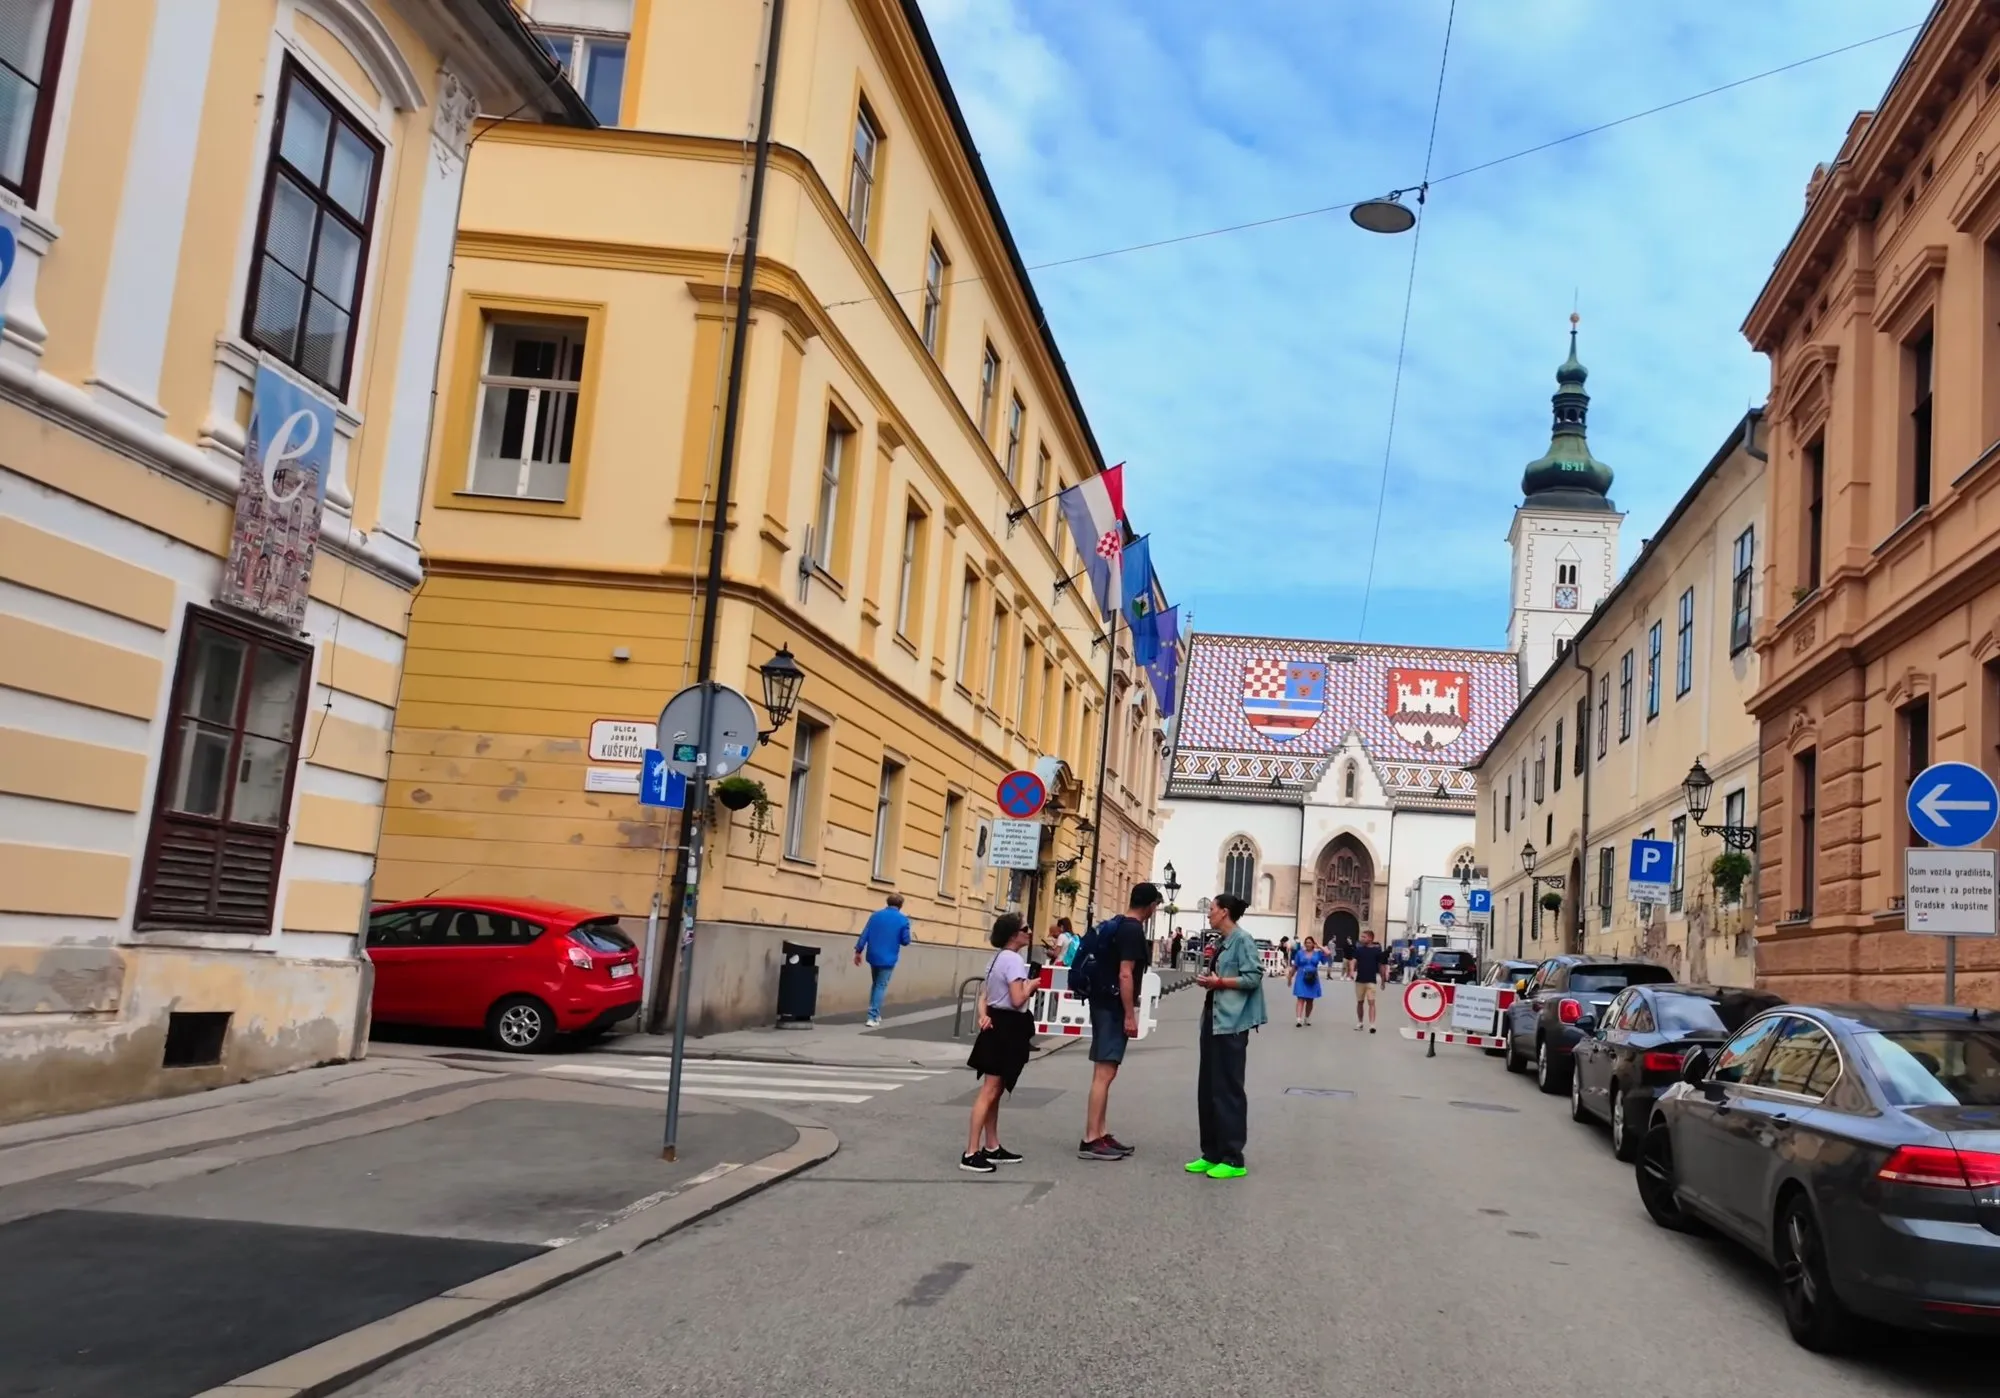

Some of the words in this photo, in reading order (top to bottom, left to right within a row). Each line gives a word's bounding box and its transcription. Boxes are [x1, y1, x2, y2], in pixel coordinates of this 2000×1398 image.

[263, 409, 320, 503] e
[1641, 847, 1661, 873] P
[1909, 867, 1926, 875] Osim
[1930, 868, 1951, 876] vozila
[1910, 885, 1939, 893] dostave
[1962, 886, 1992, 896] potrebe
[1440, 898, 1454, 907] STOP
[1475, 893, 1485, 908] P
[1914, 900, 1945, 909] Gradske
